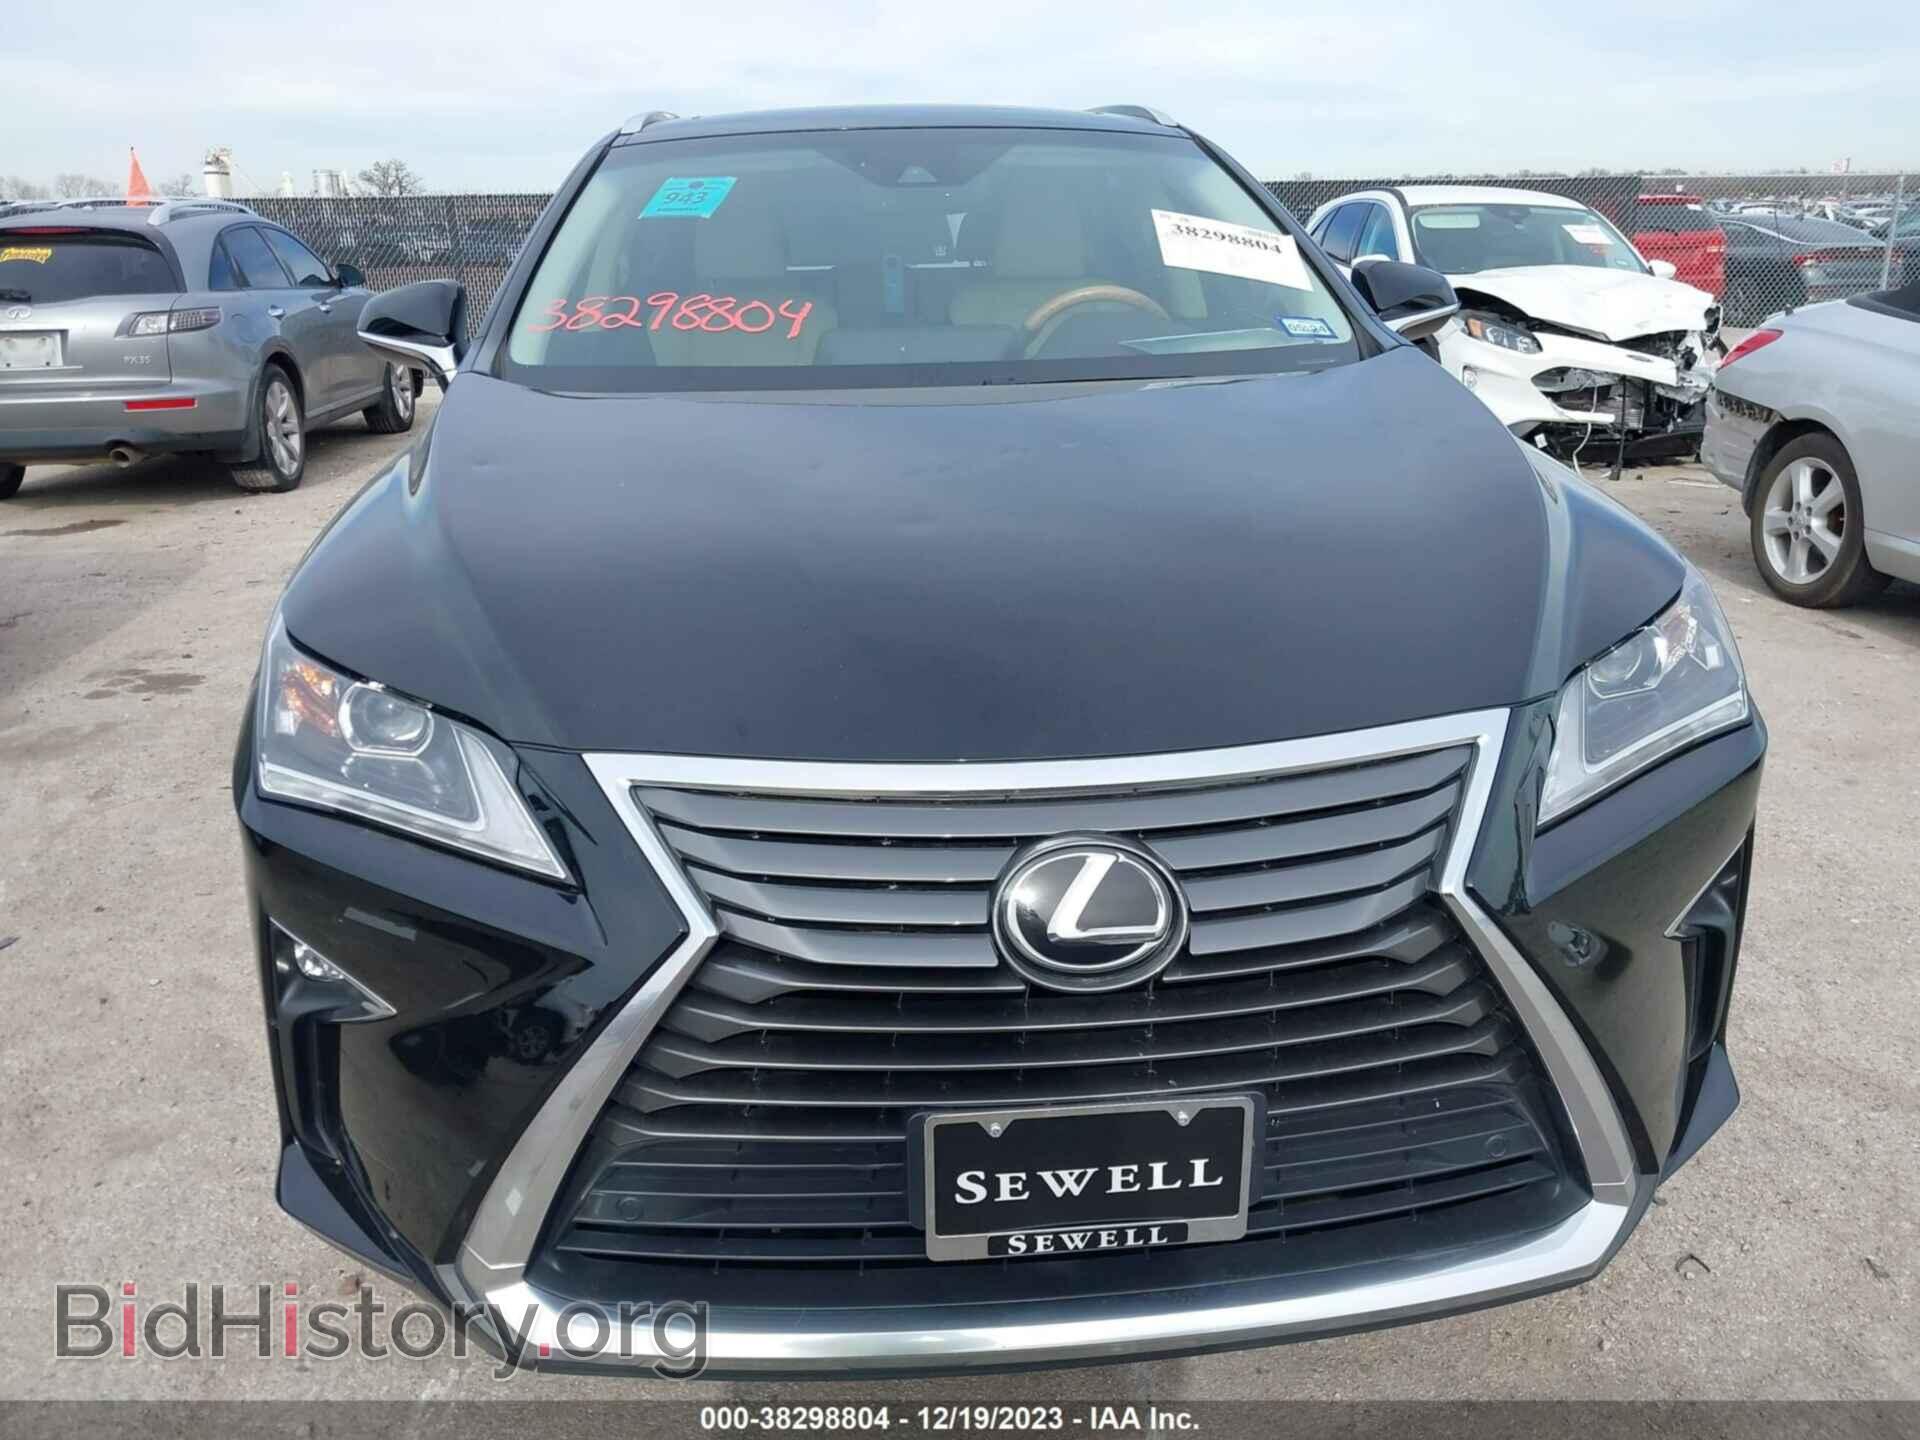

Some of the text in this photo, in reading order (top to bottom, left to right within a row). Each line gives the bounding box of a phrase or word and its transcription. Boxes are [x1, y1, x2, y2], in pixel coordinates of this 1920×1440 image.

[664, 192, 707, 205] 943
[1170, 223, 1283, 254] 38298804
[529, 293, 813, 339] 38298804
[955, 1158, 1223, 1204] SEWELL
[1007, 1226, 1169, 1255] SEWELL
